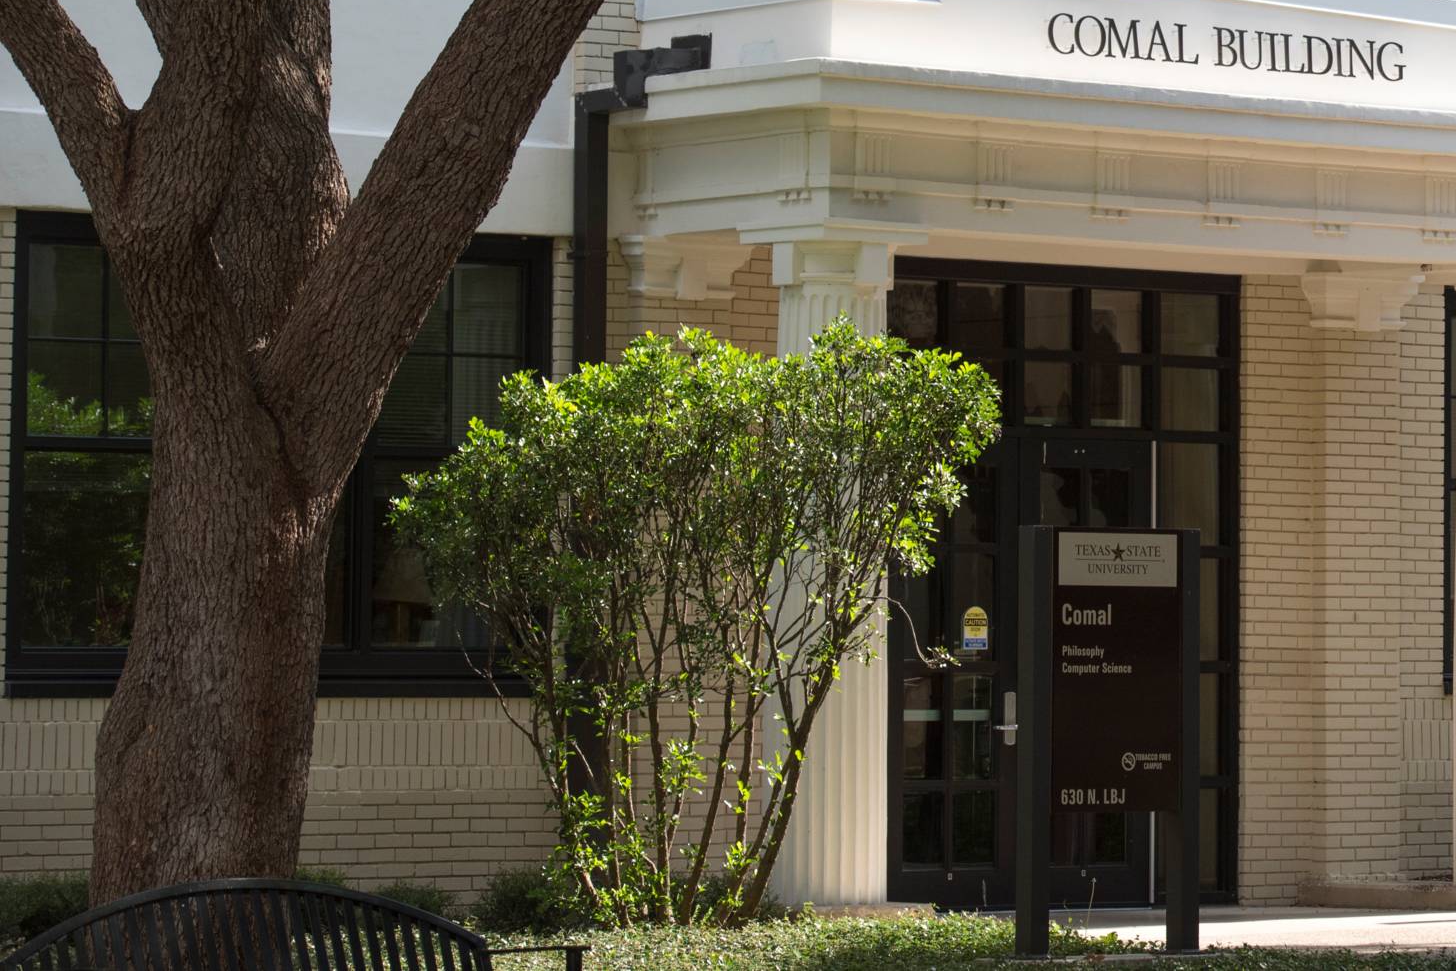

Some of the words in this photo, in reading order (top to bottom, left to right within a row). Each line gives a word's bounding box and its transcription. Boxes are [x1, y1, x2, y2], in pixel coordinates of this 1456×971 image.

[1047, 12, 1200, 66] COMAL
[1212, 26, 1407, 82] BUILDING
[1074, 543, 1111, 557] TEXAS
[1126, 545, 1161, 558] STATE
[1087, 563, 1149, 575] UNIVERSITY
[1062, 603, 1112, 626] Comal
[1062, 645, 1105, 659] Philosophy
[1062, 662, 1100, 676] Computer
[1102, 662, 1133, 674] Science
[1135, 753, 1158, 762] TOBACCO
[1143, 762, 1163, 770] CAMPUS
[1061, 788, 1084, 805] 630
[1087, 788, 1100, 805] N.
[1103, 788, 1126, 805] LBJ
